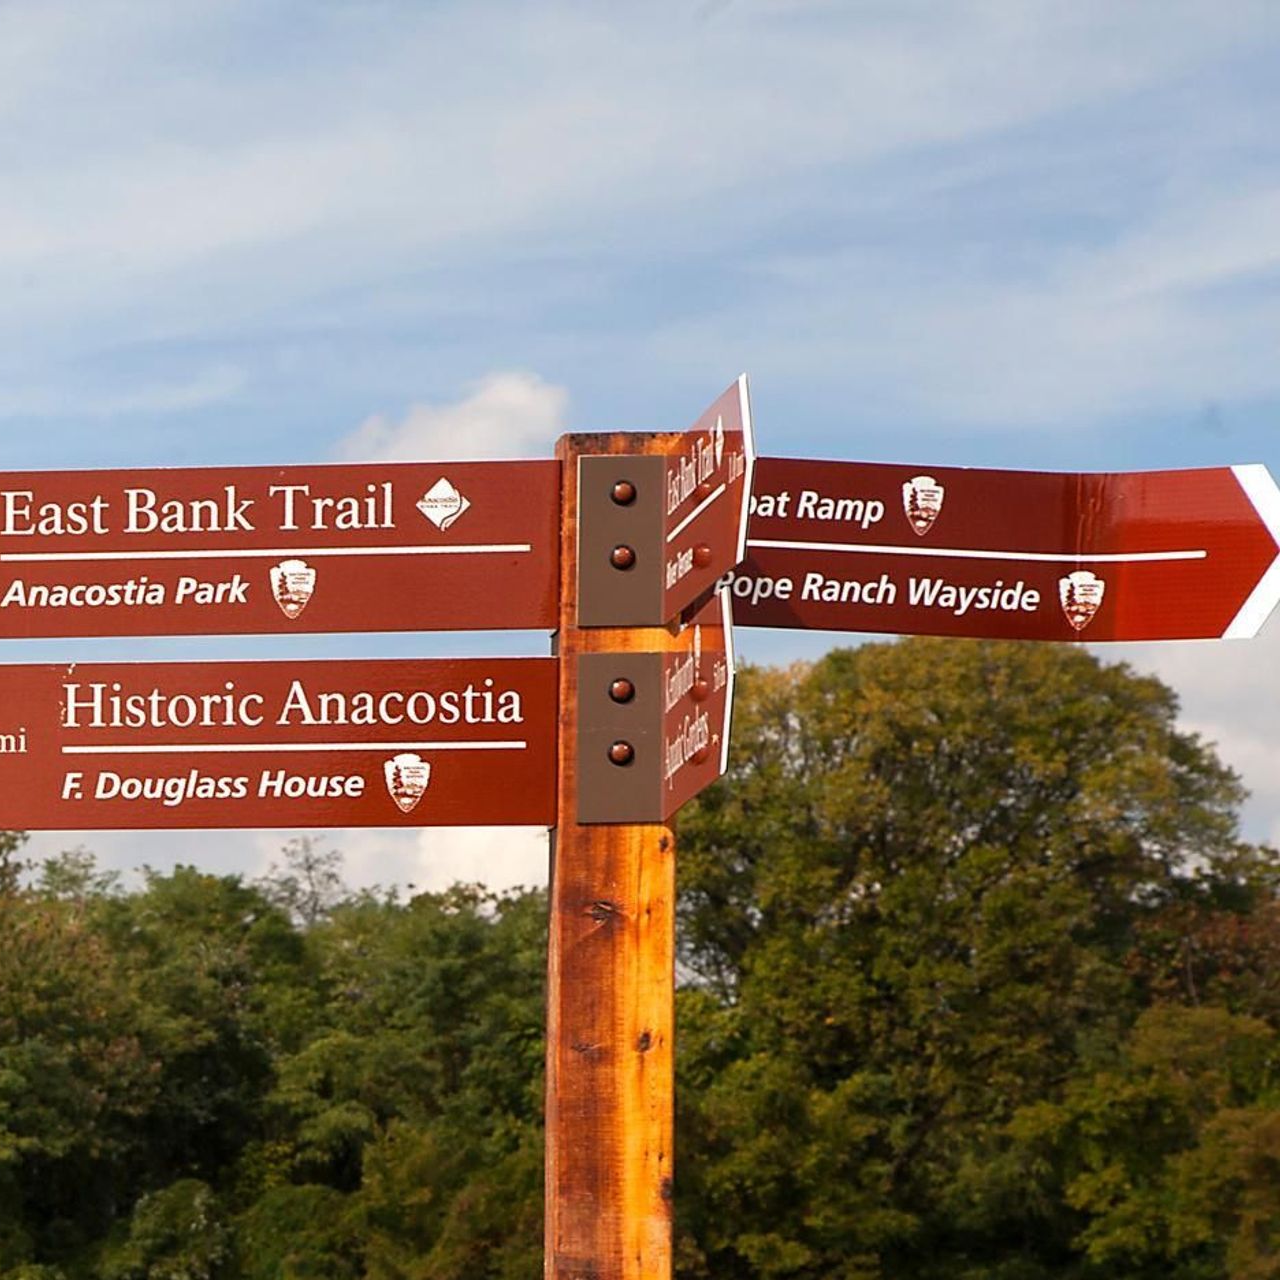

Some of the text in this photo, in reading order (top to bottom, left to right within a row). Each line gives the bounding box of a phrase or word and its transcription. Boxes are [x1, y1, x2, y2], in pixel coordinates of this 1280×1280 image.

[0, 481, 396, 535] East Bank Trail
[796, 489, 885, 530] Ramp
[0, 574, 250, 608] Anacostia Park
[801, 572, 897, 605] Ranch
[908, 577, 1042, 615] Wayside
[61, 678, 524, 729] Historic Anacostia
[61, 768, 366, 808] F. Douglass House
